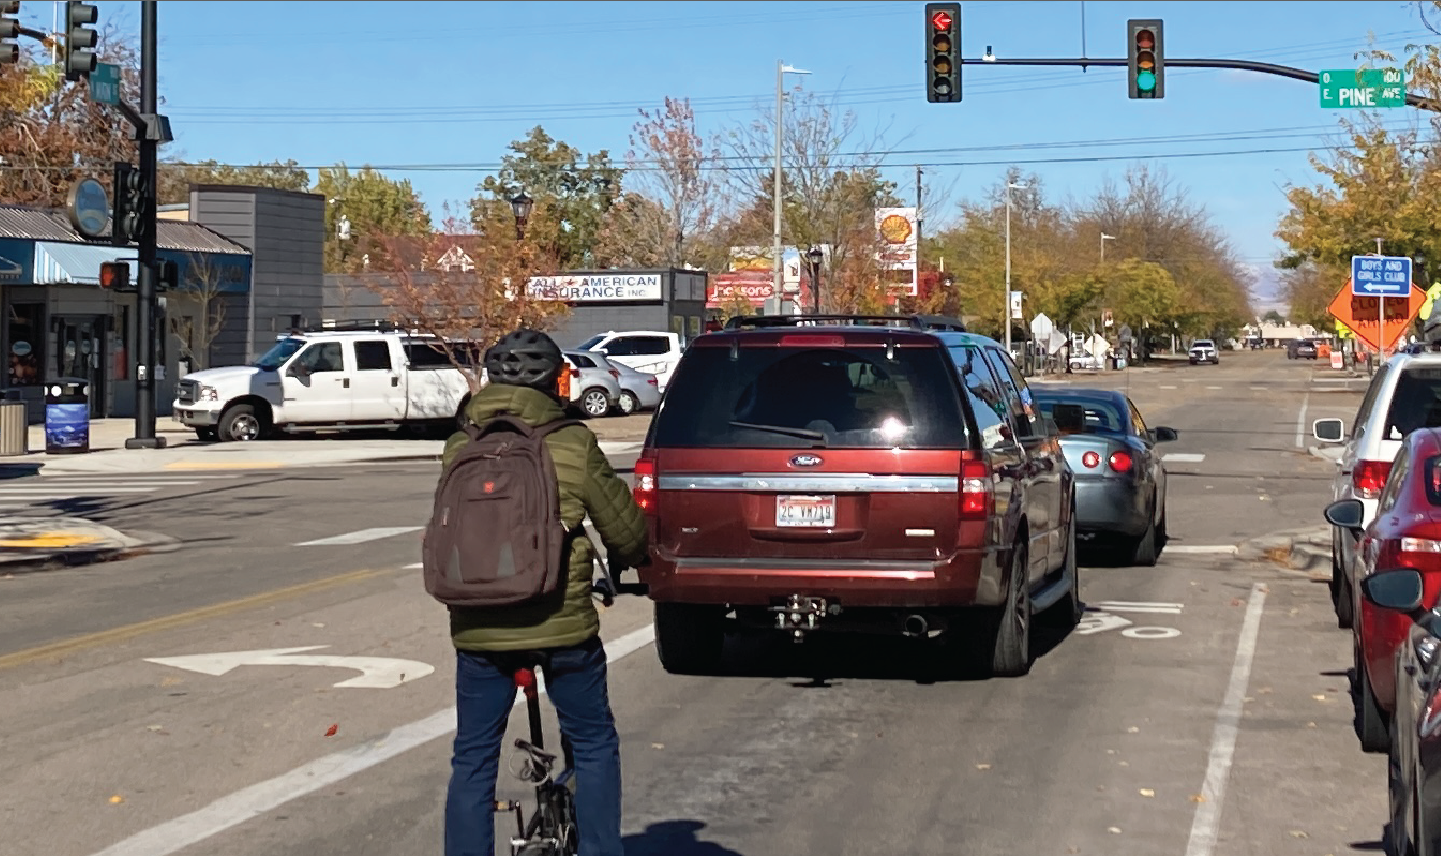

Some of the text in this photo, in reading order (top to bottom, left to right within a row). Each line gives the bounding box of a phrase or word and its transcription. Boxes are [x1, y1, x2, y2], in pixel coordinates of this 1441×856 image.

[1339, 88, 1376, 106] PINE
[1381, 87, 1401, 99] AVE
[1385, 260, 1403, 271] AND
[581, 276, 658, 287] AMERICAN
[1384, 272, 1405, 282] CLUB
[711, 284, 772, 298] Jacsons
[1350, 297, 1405, 312] CLOED
[1358, 312, 1404, 329] AHAD
